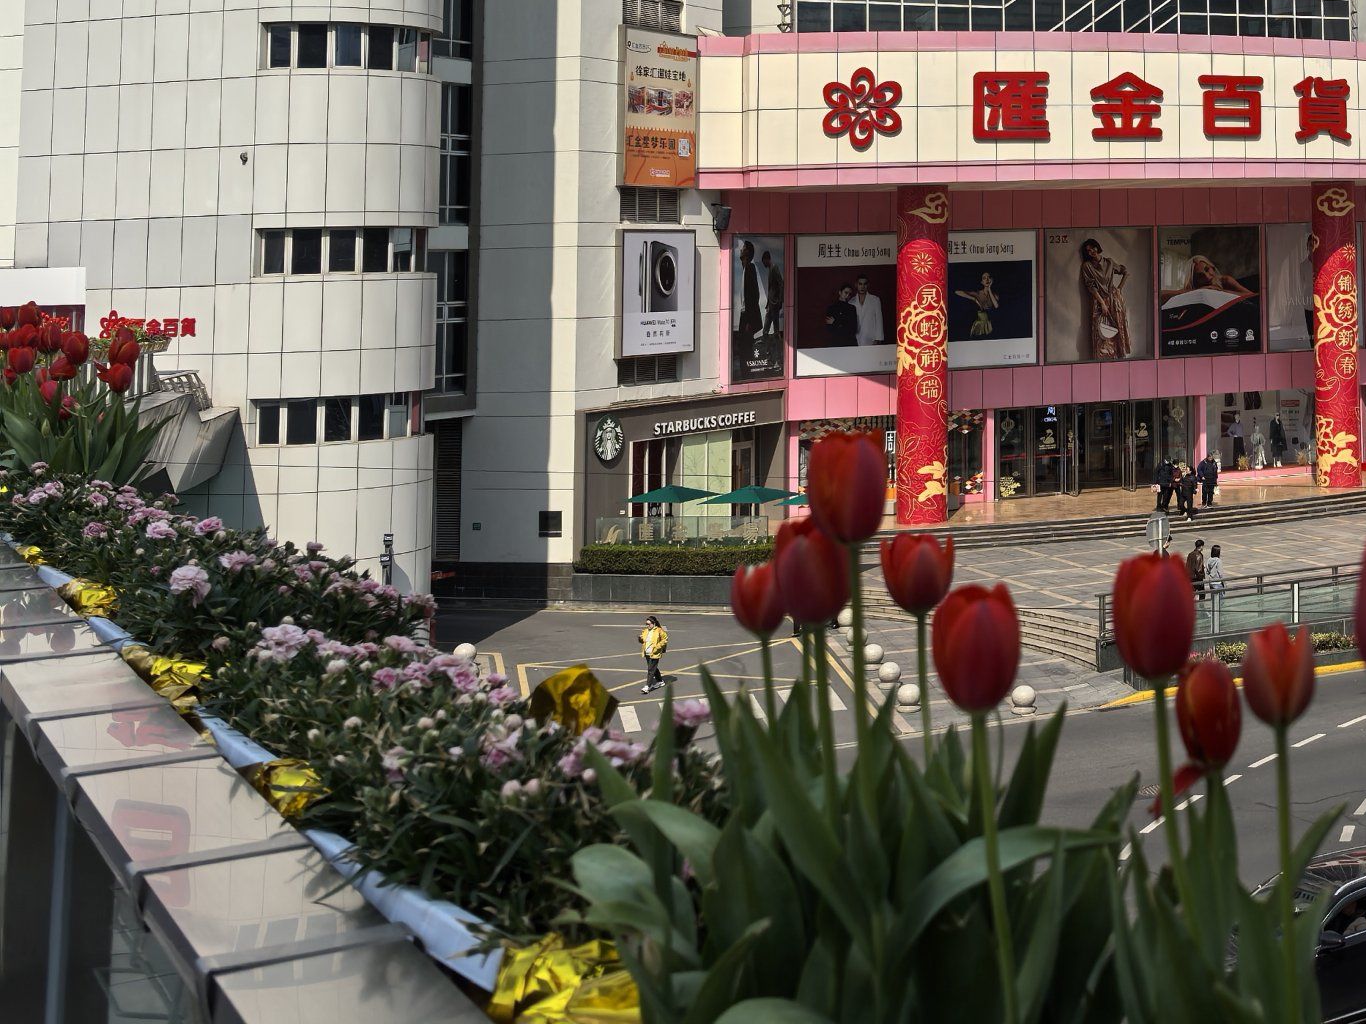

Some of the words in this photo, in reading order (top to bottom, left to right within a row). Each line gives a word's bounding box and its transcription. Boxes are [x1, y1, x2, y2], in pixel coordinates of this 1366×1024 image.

[973, 71, 1352, 146] 匯金百貨
[818, 243, 842, 258] 周生生
[919, 287, 940, 399] 灵蛇祥瑞
[654, 415, 717, 435] STARBUCKS
[718, 411, 756, 427] COFFEE
